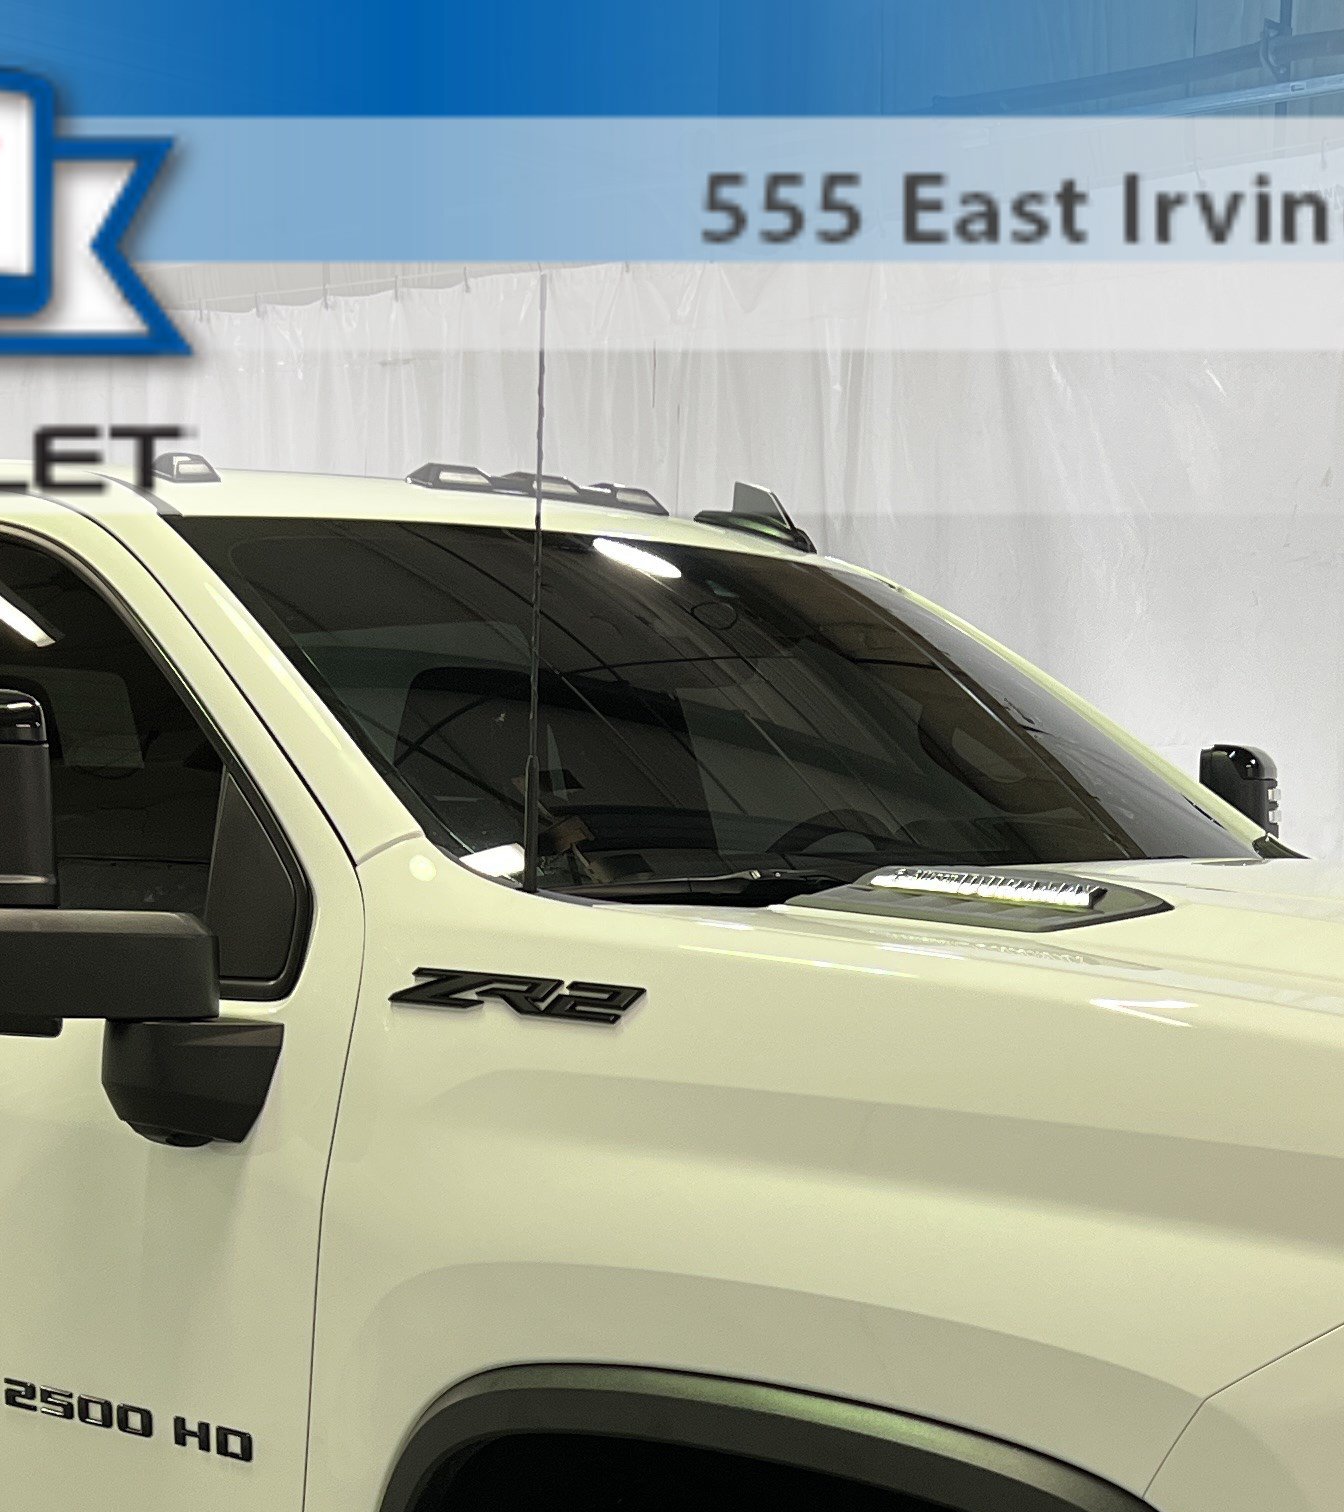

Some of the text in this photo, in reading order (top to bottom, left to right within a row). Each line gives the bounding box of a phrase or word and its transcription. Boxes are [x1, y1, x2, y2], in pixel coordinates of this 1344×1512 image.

[387, 966, 647, 1025] ZR2
[3, 1377, 254, 1463] 2500 HD
